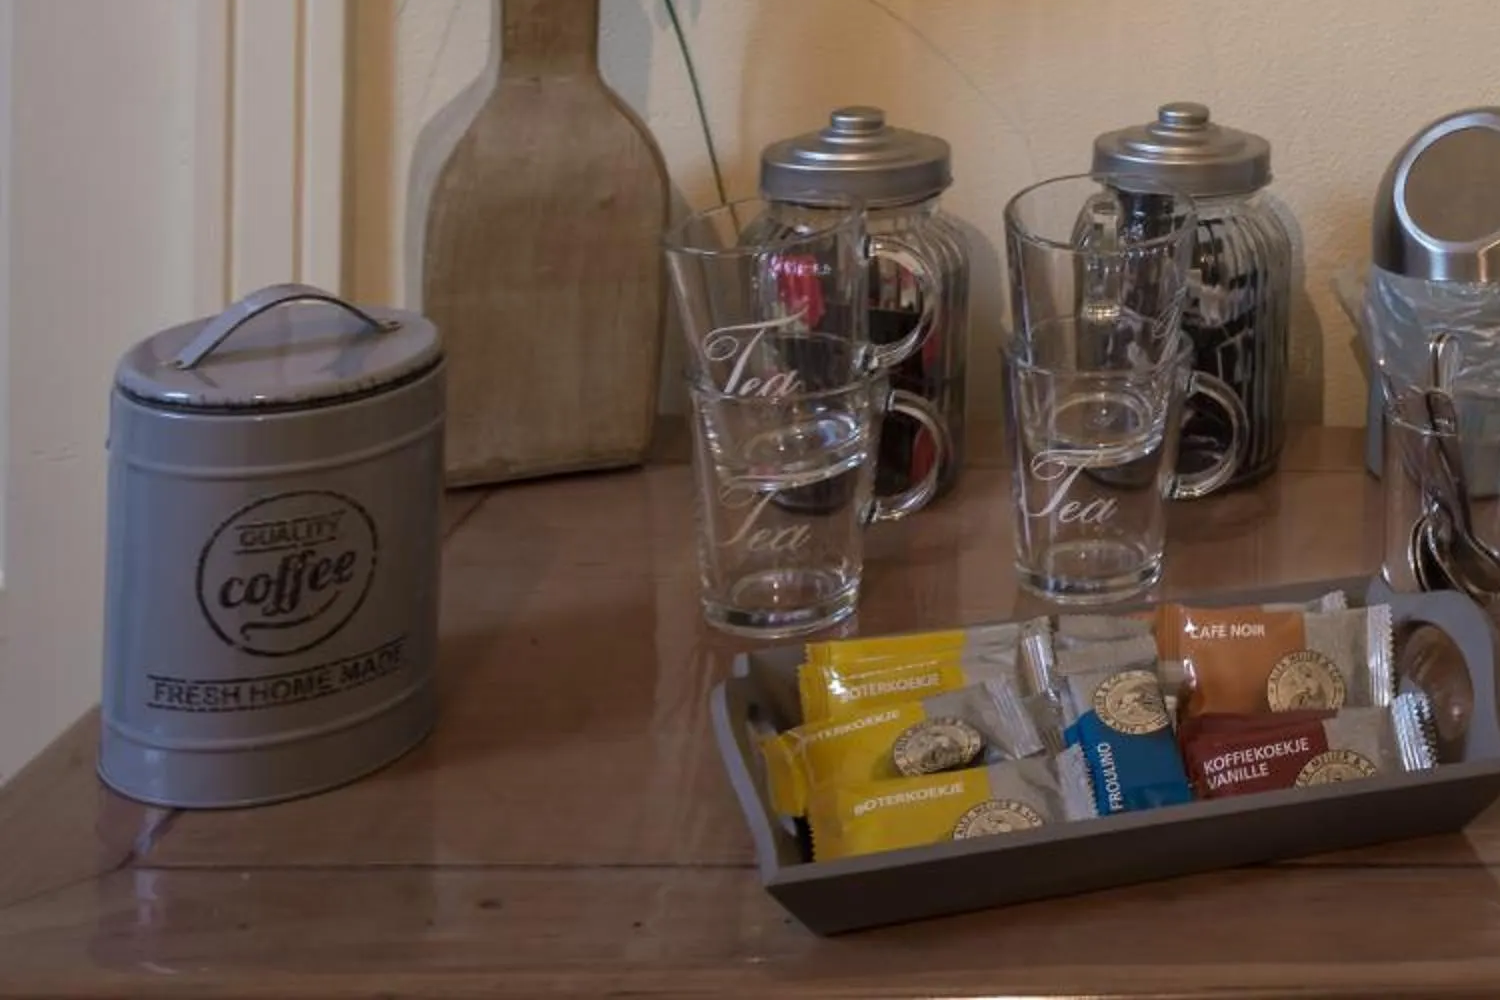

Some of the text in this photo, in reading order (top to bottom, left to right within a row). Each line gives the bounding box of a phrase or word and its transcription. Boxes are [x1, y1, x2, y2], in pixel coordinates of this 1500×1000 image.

[703, 303, 806, 396] Tea
[717, 476, 811, 550] Tea
[1027, 450, 1118, 523] Tea
[240, 518, 340, 546] QUALITY
[219, 549, 356, 617] coffee
[1230, 623, 1265, 638] NOIR
[153, 645, 404, 705] FRESH HOME MADE
[1203, 737, 1310, 775] KOFFIEKOEKJE
[1207, 762, 1270, 790] VANILLE
